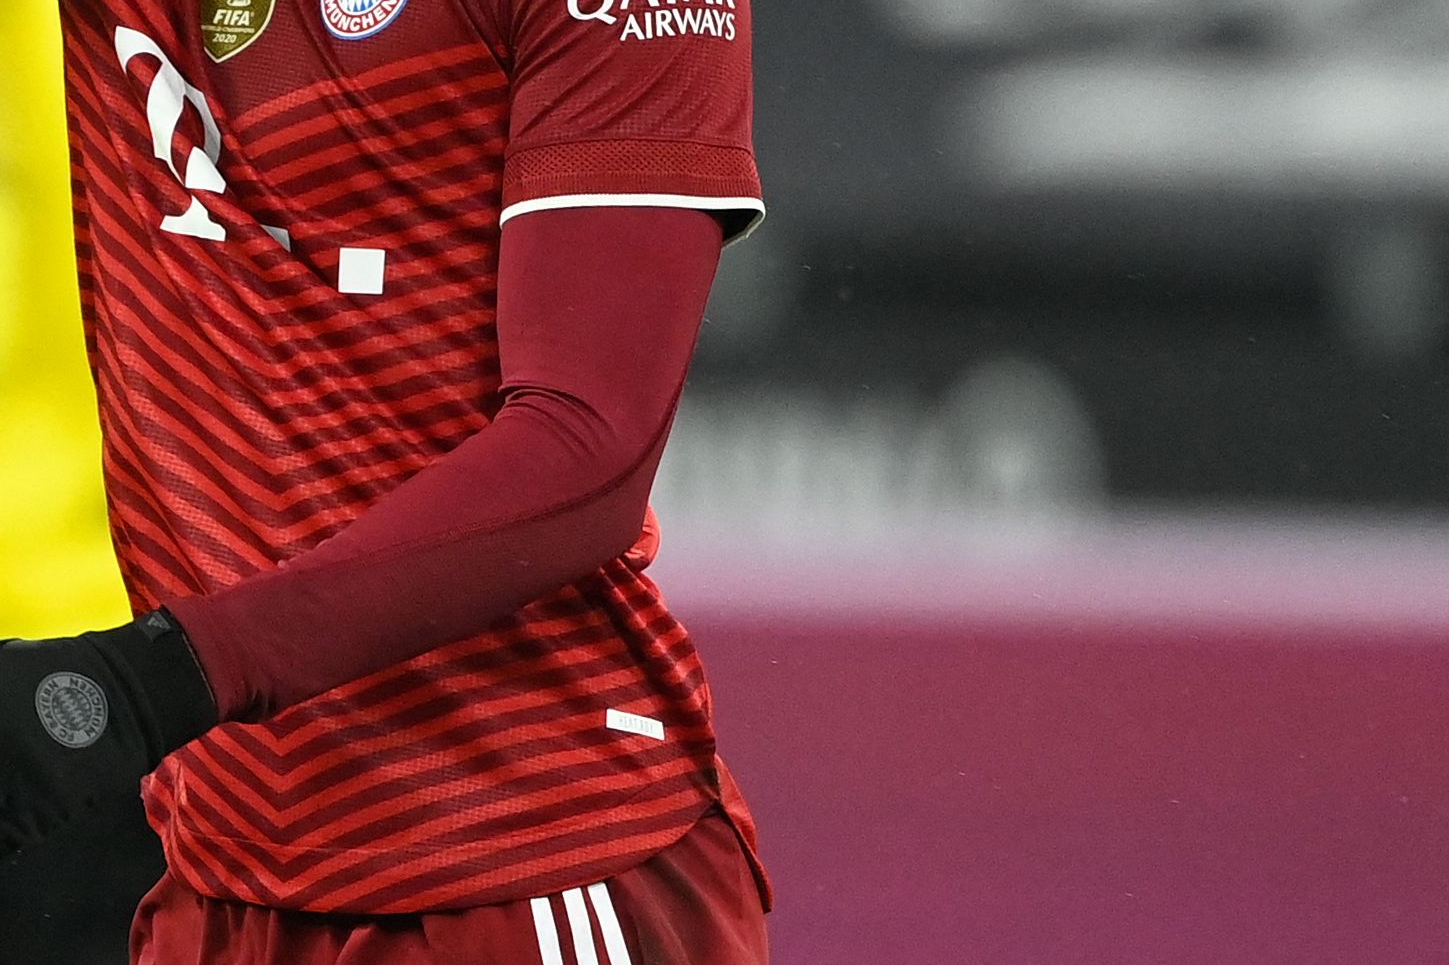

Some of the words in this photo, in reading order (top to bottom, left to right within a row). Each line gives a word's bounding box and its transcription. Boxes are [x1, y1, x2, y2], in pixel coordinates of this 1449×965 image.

[213, 9, 250, 26] FIFA
[620, 8, 735, 41] AIRWAYS
[212, 33, 238, 44] 2020
